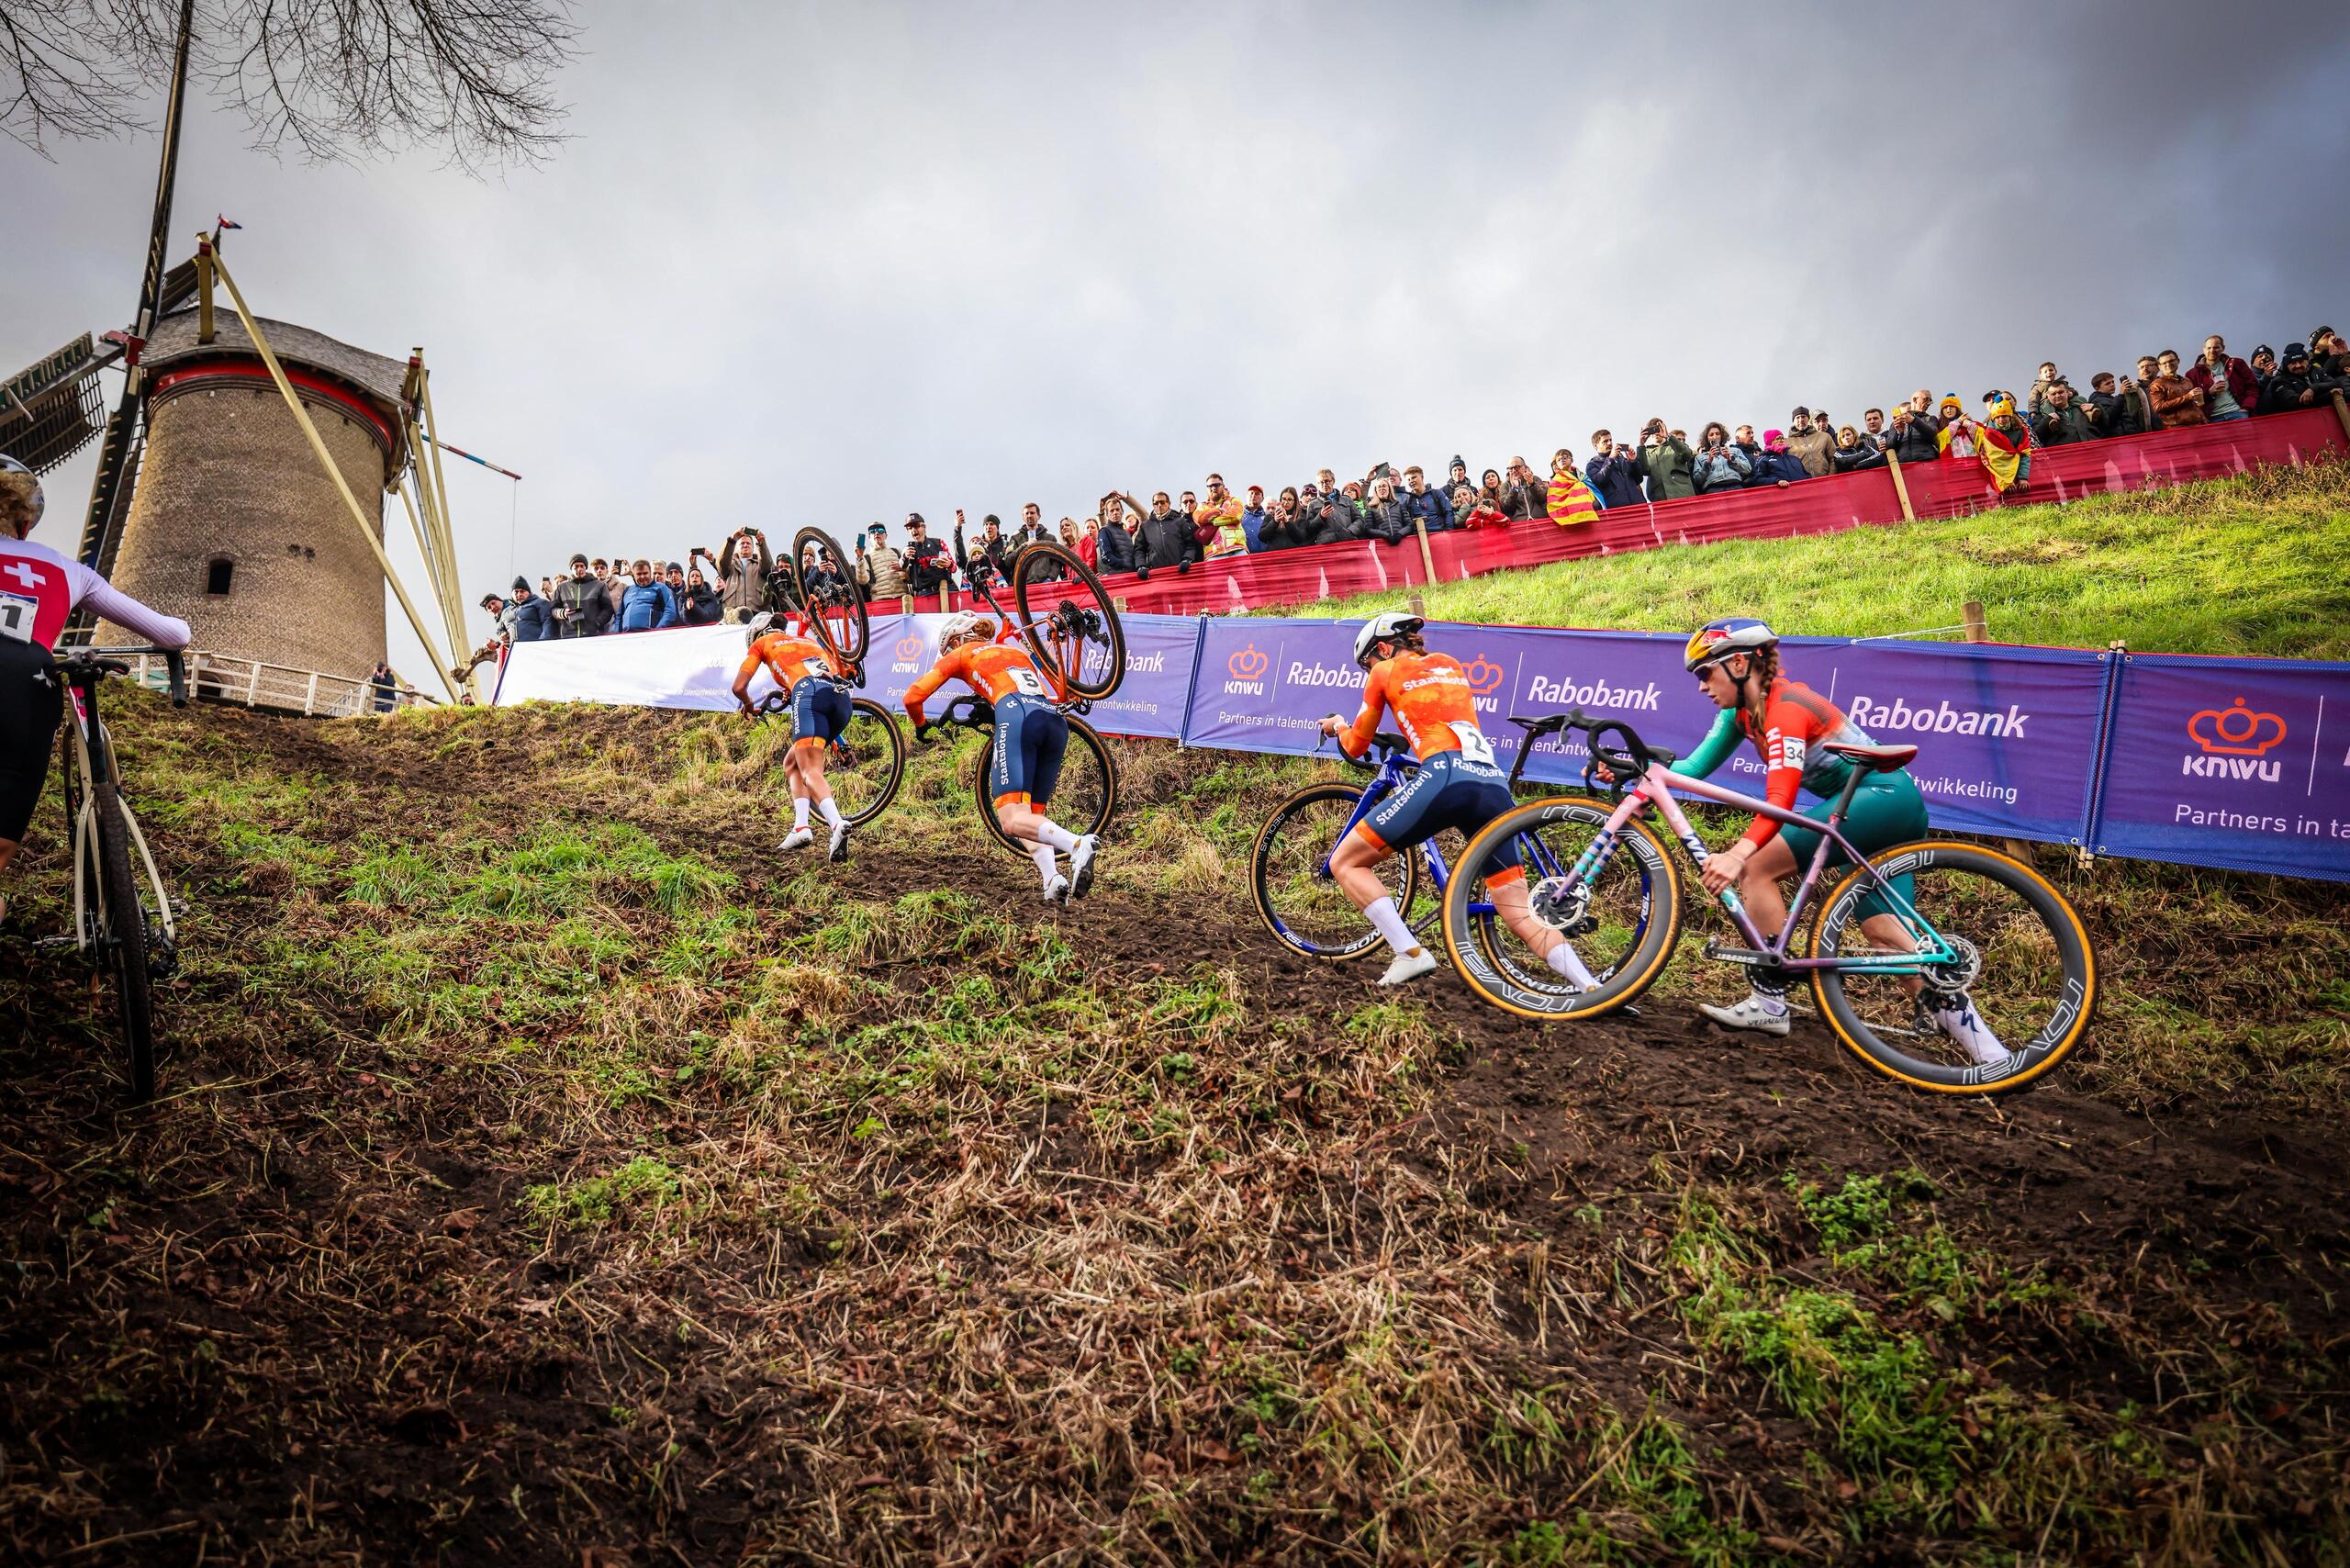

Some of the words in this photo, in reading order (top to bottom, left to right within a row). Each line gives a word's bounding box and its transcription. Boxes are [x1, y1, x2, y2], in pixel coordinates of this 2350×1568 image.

[1085, 648, 1165, 672] Rabbank
[1023, 673, 1038, 688] 5
[1286, 661, 1368, 689] Raboba
[1528, 675, 1662, 711] Rabobank
[1218, 711, 1262, 726] Partners
[1264, 714, 1274, 726] in
[1848, 695, 2031, 738] Rabobank
[1001, 722, 1010, 785] Staatsloterij
[1468, 731, 1488, 755] 2
[1500, 734, 1513, 749] in
[1785, 746, 1805, 762] 34
[1376, 769, 1433, 826] Staatsloterij
[1259, 812, 1285, 852] AEOLUS
[2175, 803, 2288, 833] Partners
[2297, 814, 2320, 835] in
[1281, 931, 1304, 947] RSL
